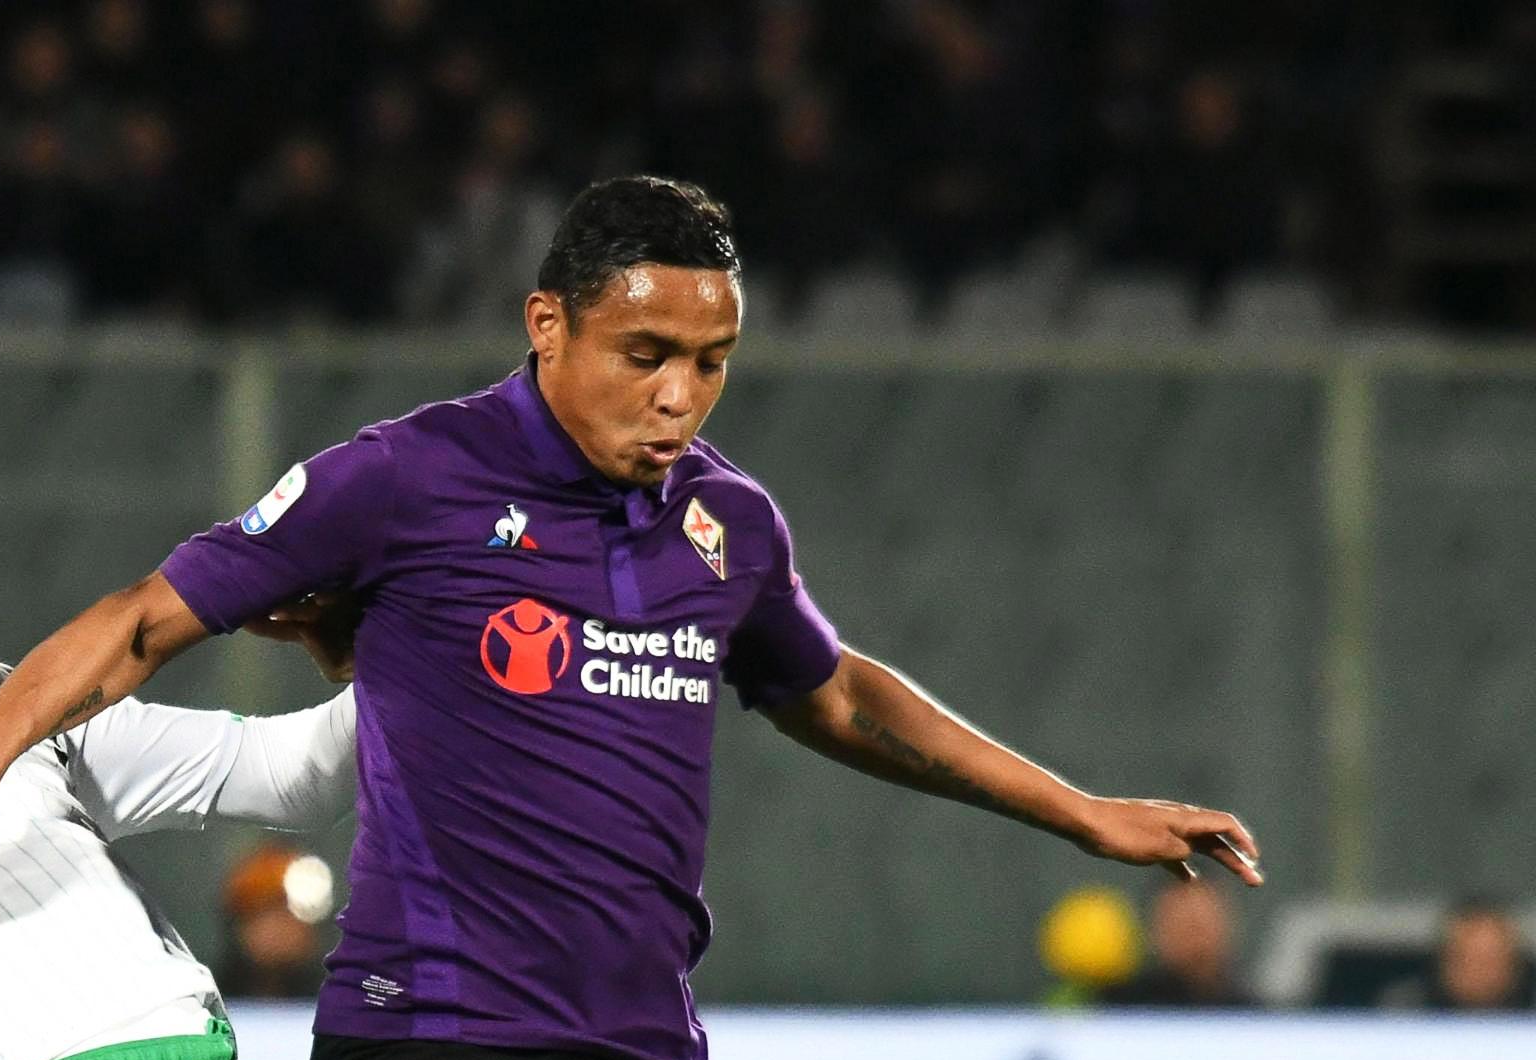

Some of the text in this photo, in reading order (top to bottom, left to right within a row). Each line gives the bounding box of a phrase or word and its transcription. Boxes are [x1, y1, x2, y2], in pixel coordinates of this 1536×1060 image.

[582, 619, 716, 663] Save the
[580, 658, 710, 704] Children
